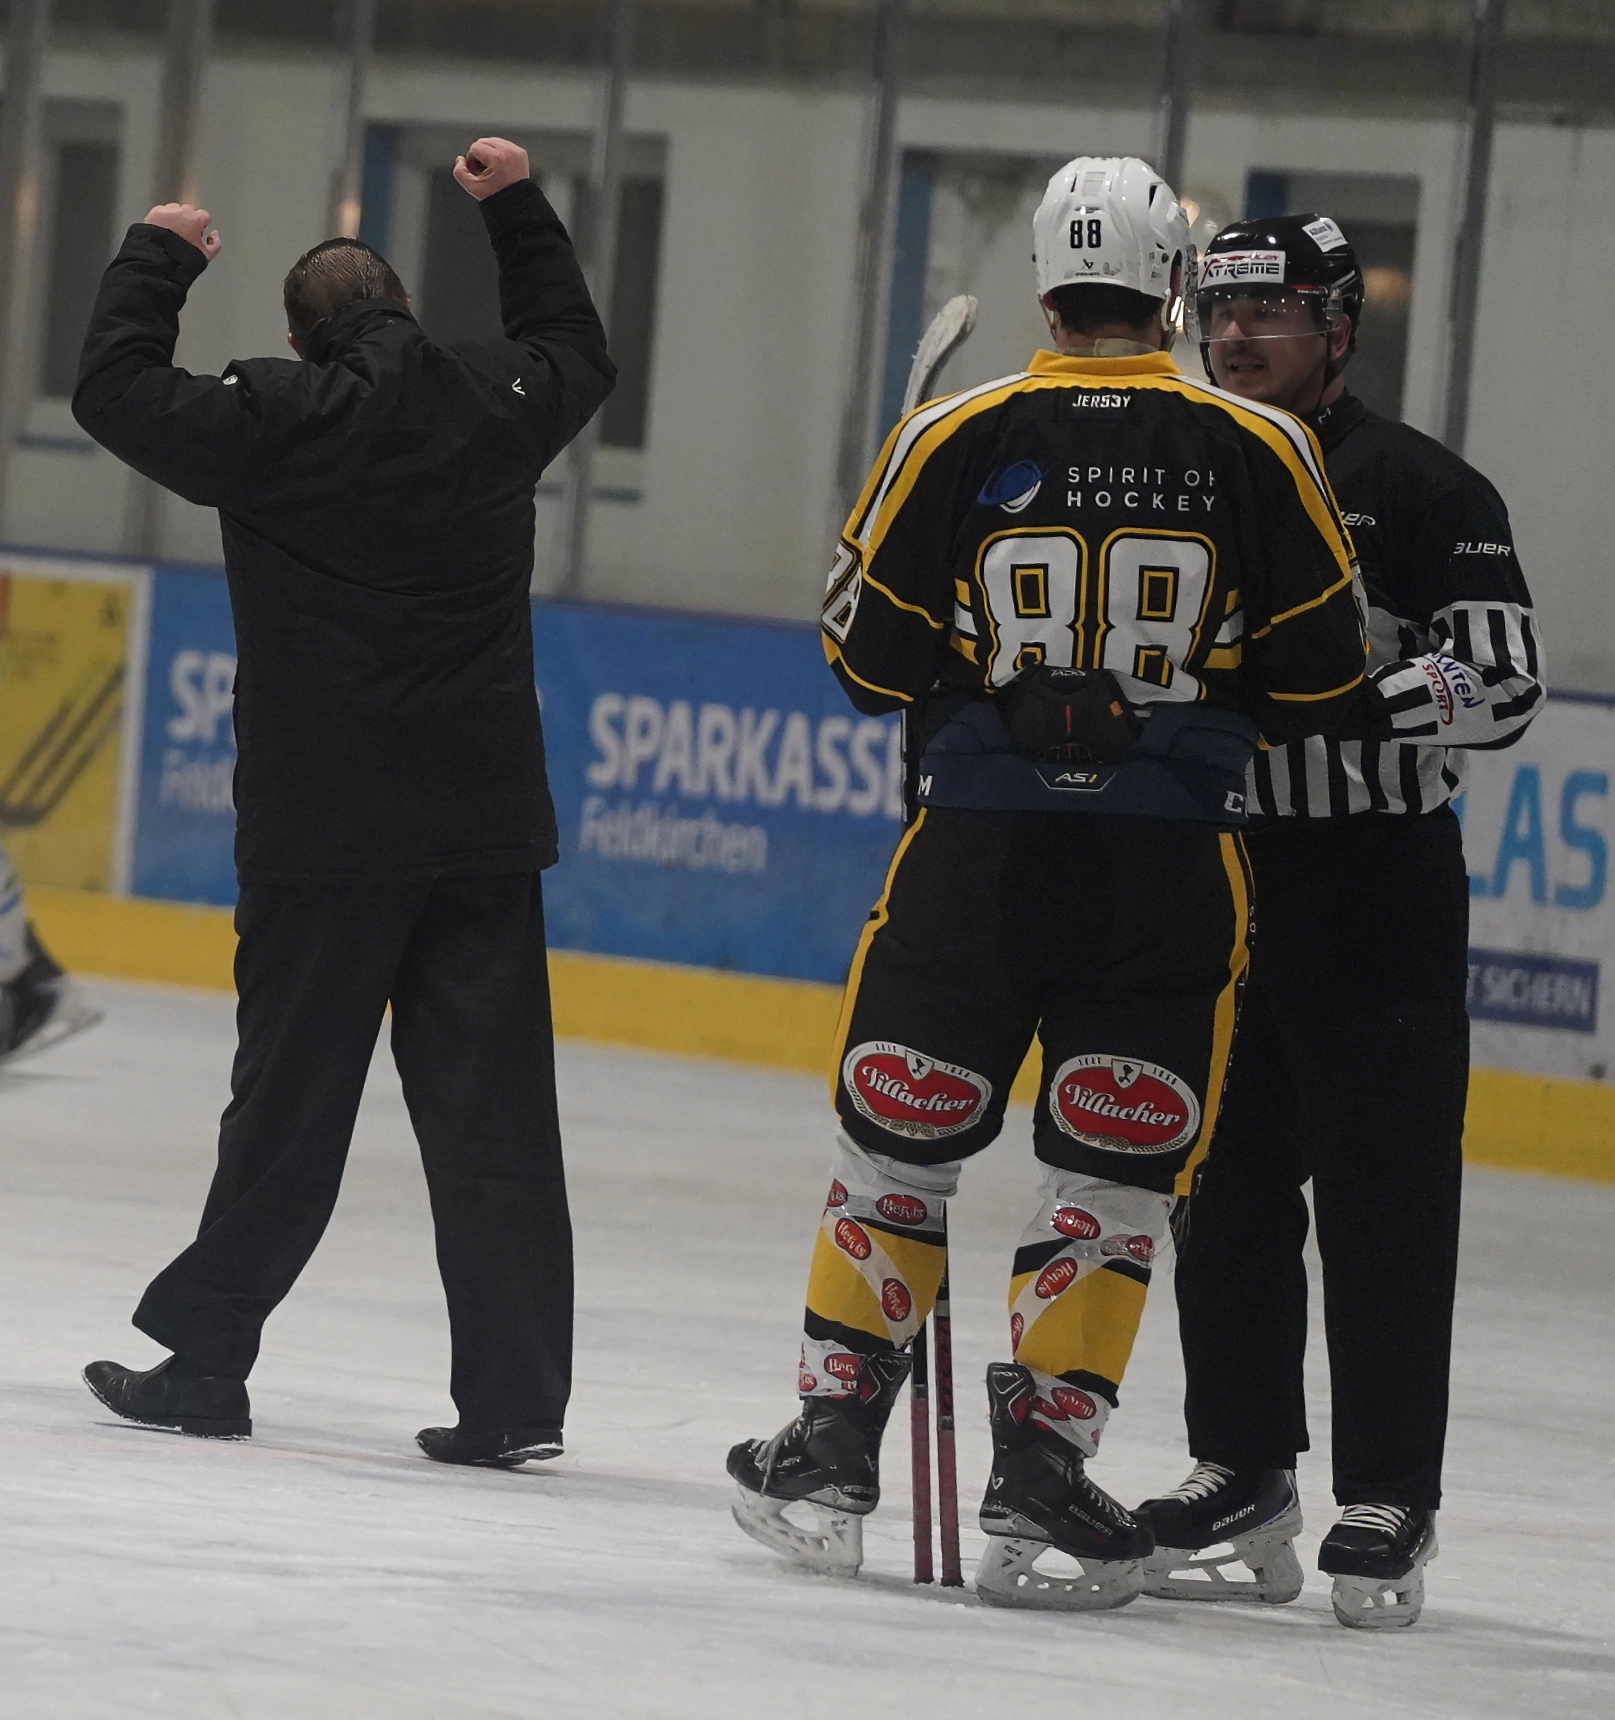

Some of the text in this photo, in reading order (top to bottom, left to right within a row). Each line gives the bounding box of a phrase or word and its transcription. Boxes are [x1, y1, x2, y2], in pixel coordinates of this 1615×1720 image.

[1070, 219, 1101, 249] 88
[1201, 259, 1280, 286] XTREME
[1067, 466, 1166, 486] SPIRIT
[1067, 490, 1216, 512] HOCKEY
[977, 528, 1216, 702] 88
[861, 1066, 974, 1111] Villacher
[1065, 1084, 1180, 1126] Villacher
[838, 1221, 867, 1258] Hervis
[1037, 1261, 1076, 1294] Hervis
[884, 1281, 907, 1320] Hervis
[1211, 1503, 1256, 1532] BAUER
